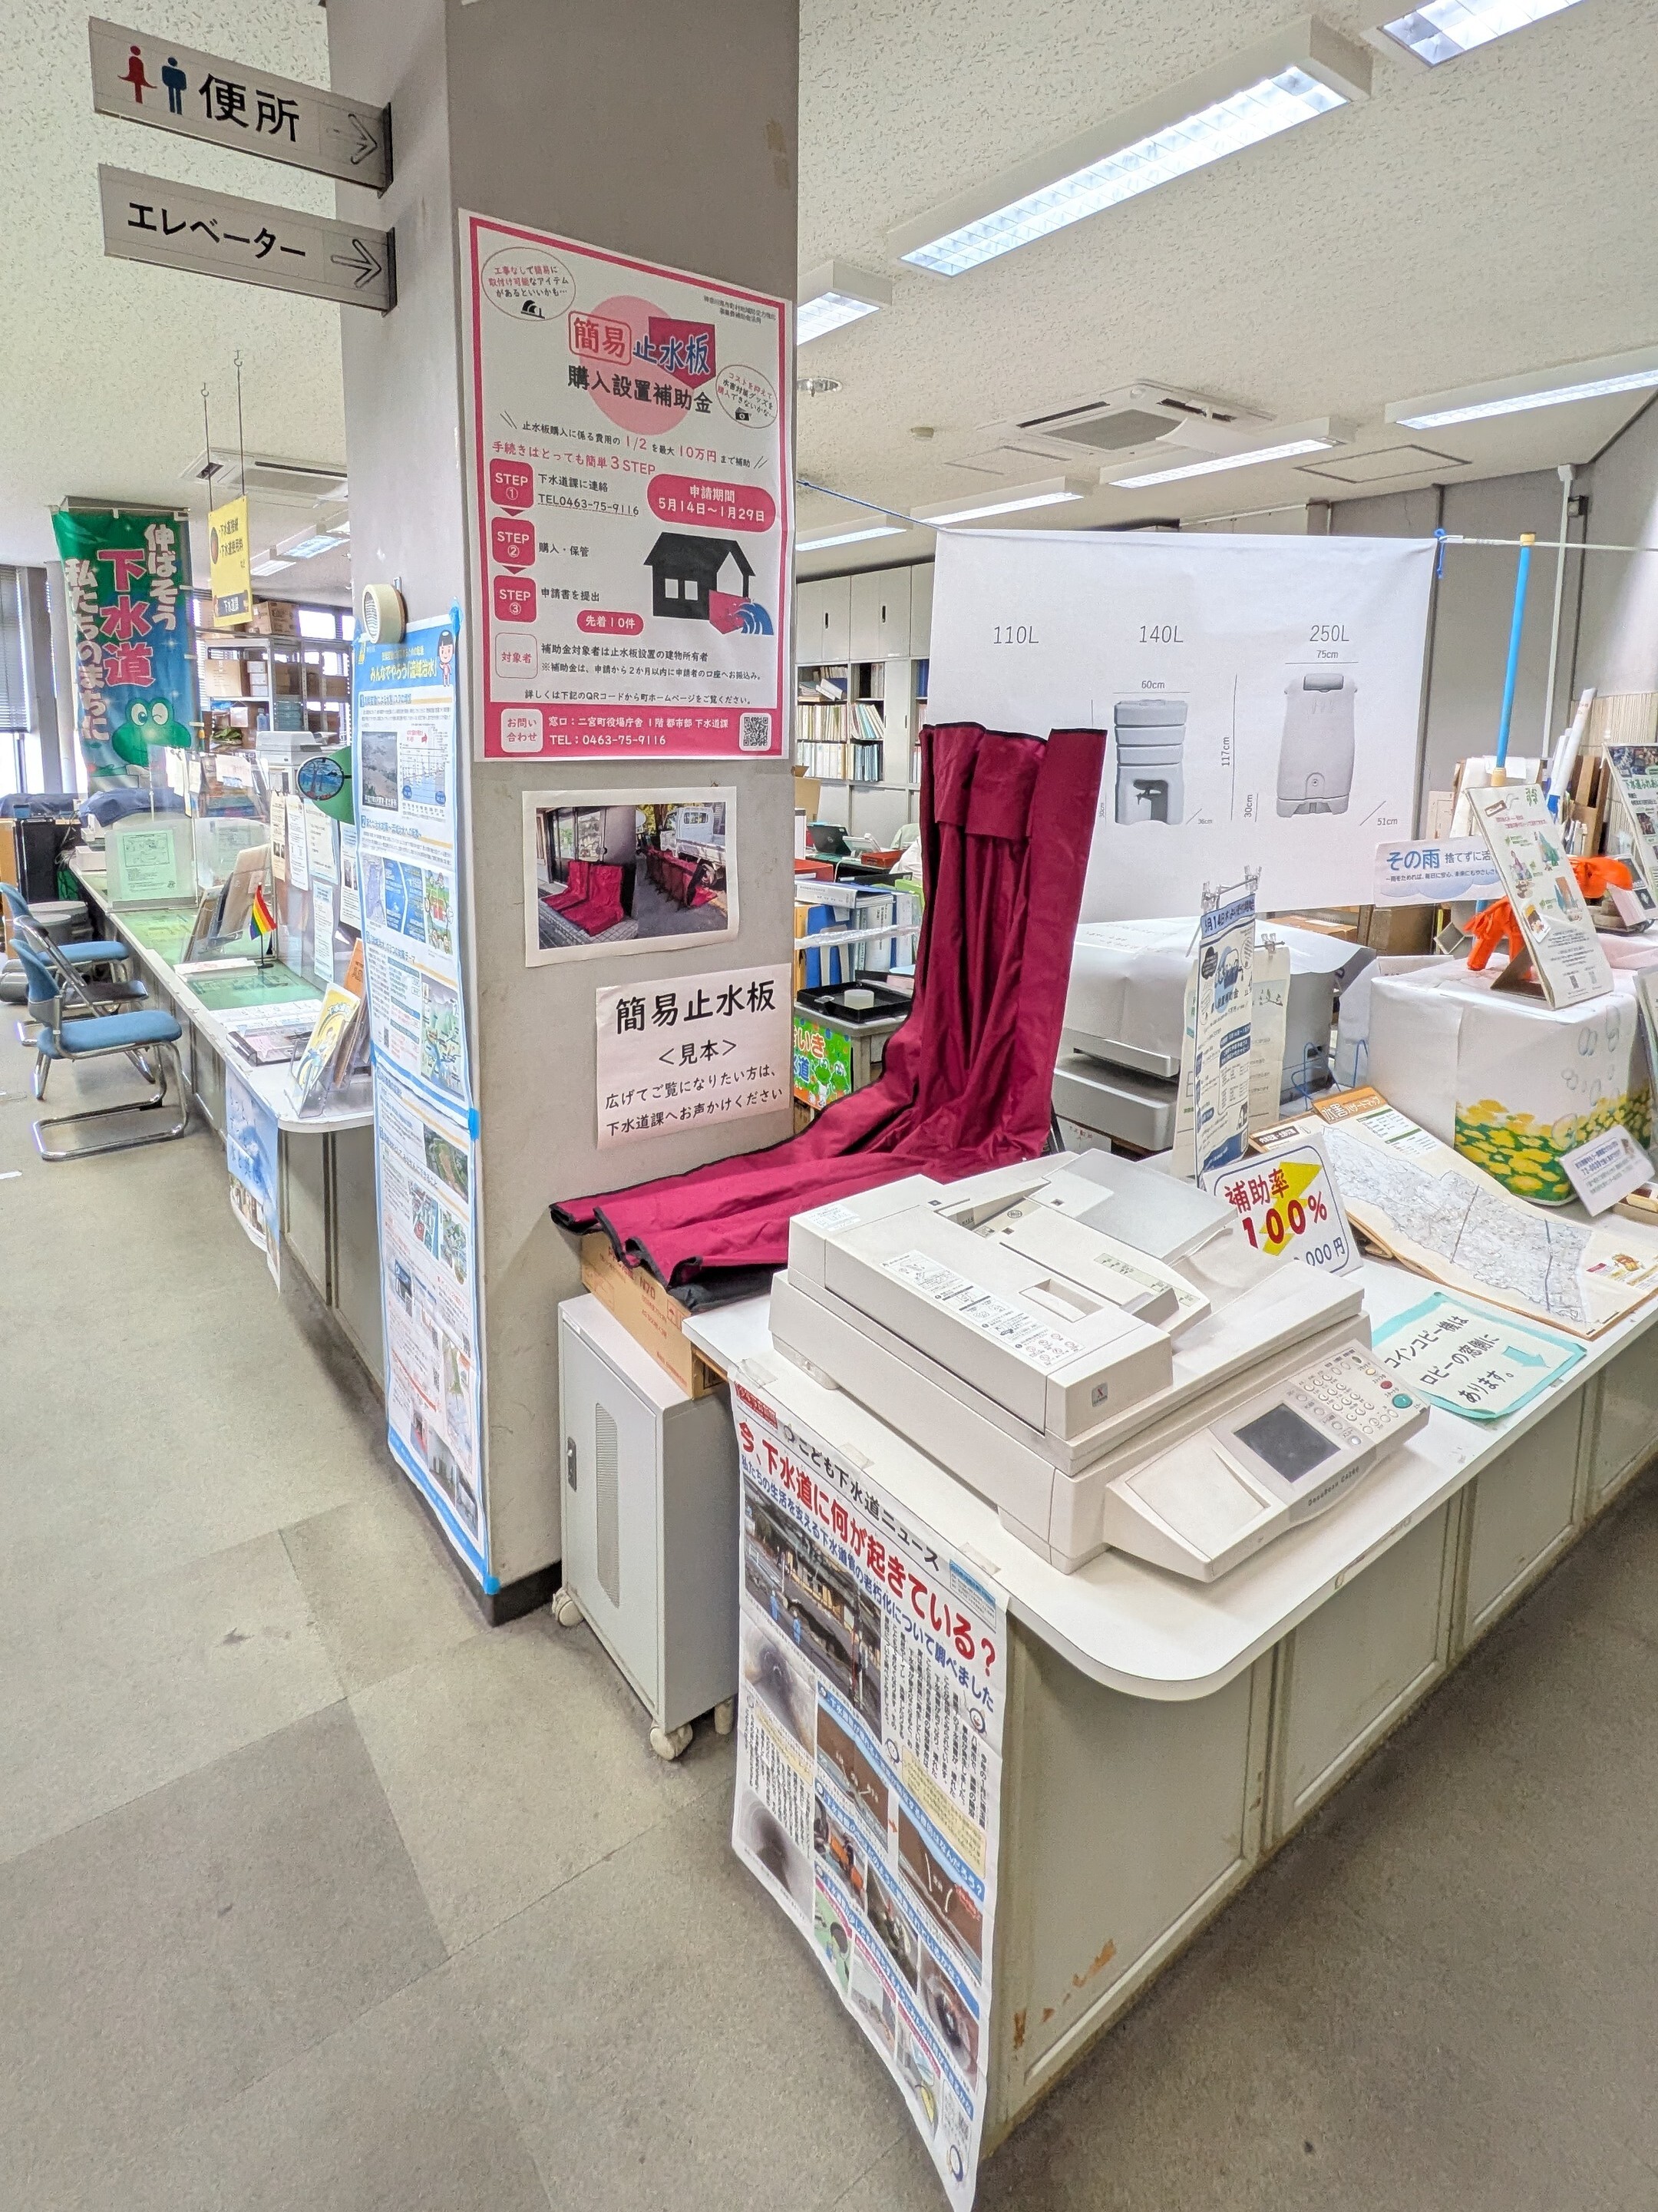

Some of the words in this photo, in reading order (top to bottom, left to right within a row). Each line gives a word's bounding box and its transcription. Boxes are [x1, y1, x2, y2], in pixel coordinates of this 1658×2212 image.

[199, 73, 300, 143] 便所
[128, 202, 306, 259] エレベーター
[494, 265, 558, 275] 工事なしで簡易に
[488, 275, 570, 287] 取付け可能なアイテム
[573, 316, 627, 359] 簡易
[632, 334, 709, 375] 止水板
[568, 365, 714, 414] 購入設置補助金
[495, 471, 529, 486] STEP
[538, 473, 608, 492] 下水道課に連絡
[689, 484, 735, 503] 申請期間
[497, 531, 530, 544] STEP
[538, 542, 589, 557] 購入・保管
[144, 523, 178, 631] 伸ばそう
[499, 588, 531, 601] STEP
[540, 587, 600, 602] 申請書を提出
[97, 548, 156, 688] 下水道
[585, 615, 636, 630] 先着10件
[993, 625, 1039, 645] 110L
[1139, 625, 1184, 644] 140L
[1310, 624, 1350, 643] 250L
[64, 558, 110, 741] 私たちのまちに
[501, 652, 532, 664] 対象者
[540, 643, 708, 662] 補助金対象者は止水板設置の建物所有者
[1316, 650, 1339, 660] 75cm
[1141, 680, 1165, 689] 60cm
[507, 718, 537, 729] お問い
[695, 718, 729, 729] 下水道課
[507, 732, 538, 742] 合わせ
[1221, 736, 1230, 766] 117cm
[1244, 794, 1253, 818] 30cm
[1377, 816, 1399, 826] 51cm
[1386, 848, 1441, 871] その雨
[616, 980, 776, 1035] 簡易止水板
[605, 1064, 775, 1109] 広げてご覧になりたい方は、
[606, 1087, 782, 1136] 下水道課へお声かけください
[1224, 1168, 1290, 1214] 補助率
[1242, 1191, 1328, 1249] 100%
[1384, 1314, 1469, 1369] コインコピー機は
[1420, 1334, 1500, 1385] ロビーの窓側に
[1458, 1370, 1514, 1404] あります。
[799, 1437, 939, 1572] こども下水道ニュース
